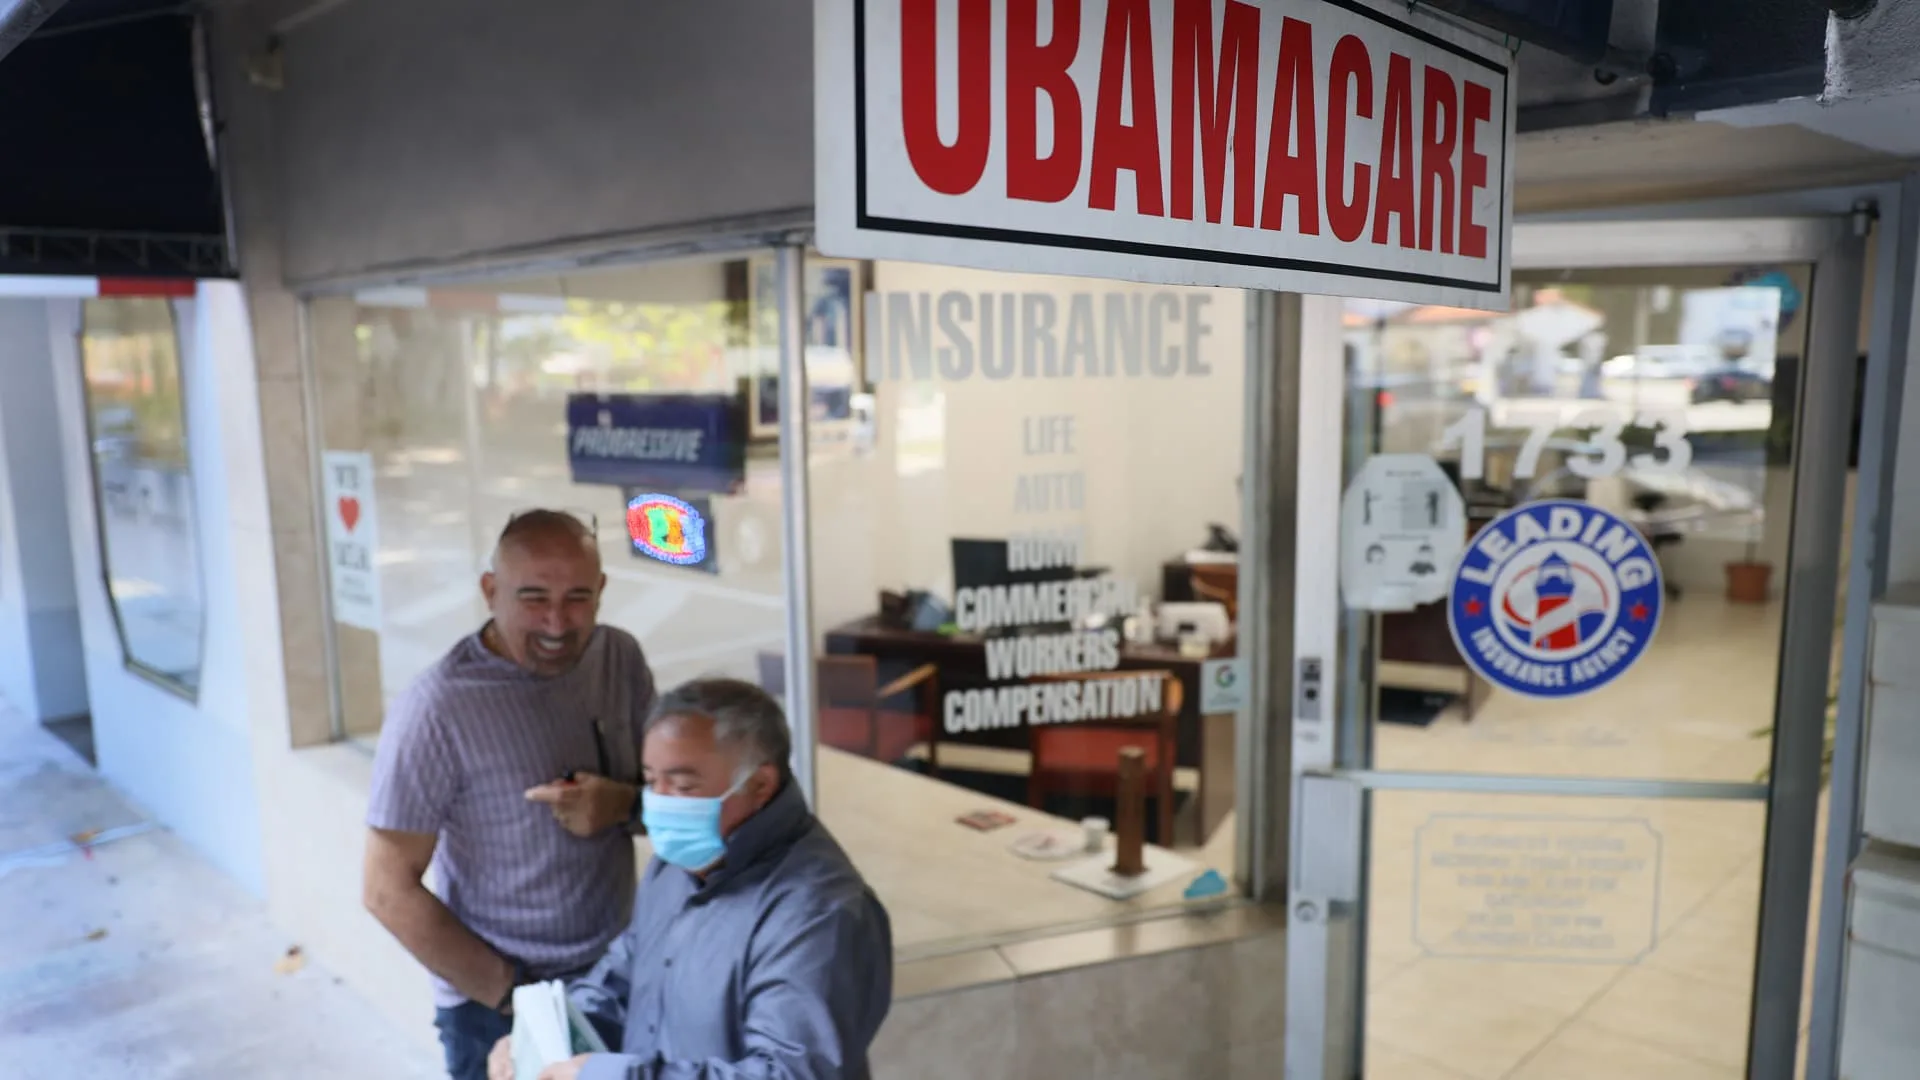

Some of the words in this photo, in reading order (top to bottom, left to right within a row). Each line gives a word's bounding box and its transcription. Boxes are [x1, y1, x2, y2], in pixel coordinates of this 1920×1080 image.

[901, 0, 1491, 259] OBAMACARE
[865, 290, 1213, 381] INSURANCE
[1022, 414, 1077, 456] LIFE
[1440, 407, 1693, 480] 1733
[1013, 472, 1085, 514] AUTO
[1460, 506, 1654, 592] LEADING
[984, 630, 1121, 681] WORKERS
[1471, 625, 1566, 687] INSURANCE
[1571, 626, 1637, 686] AGENCY
[943, 676, 1164, 734] COMPENSATION
